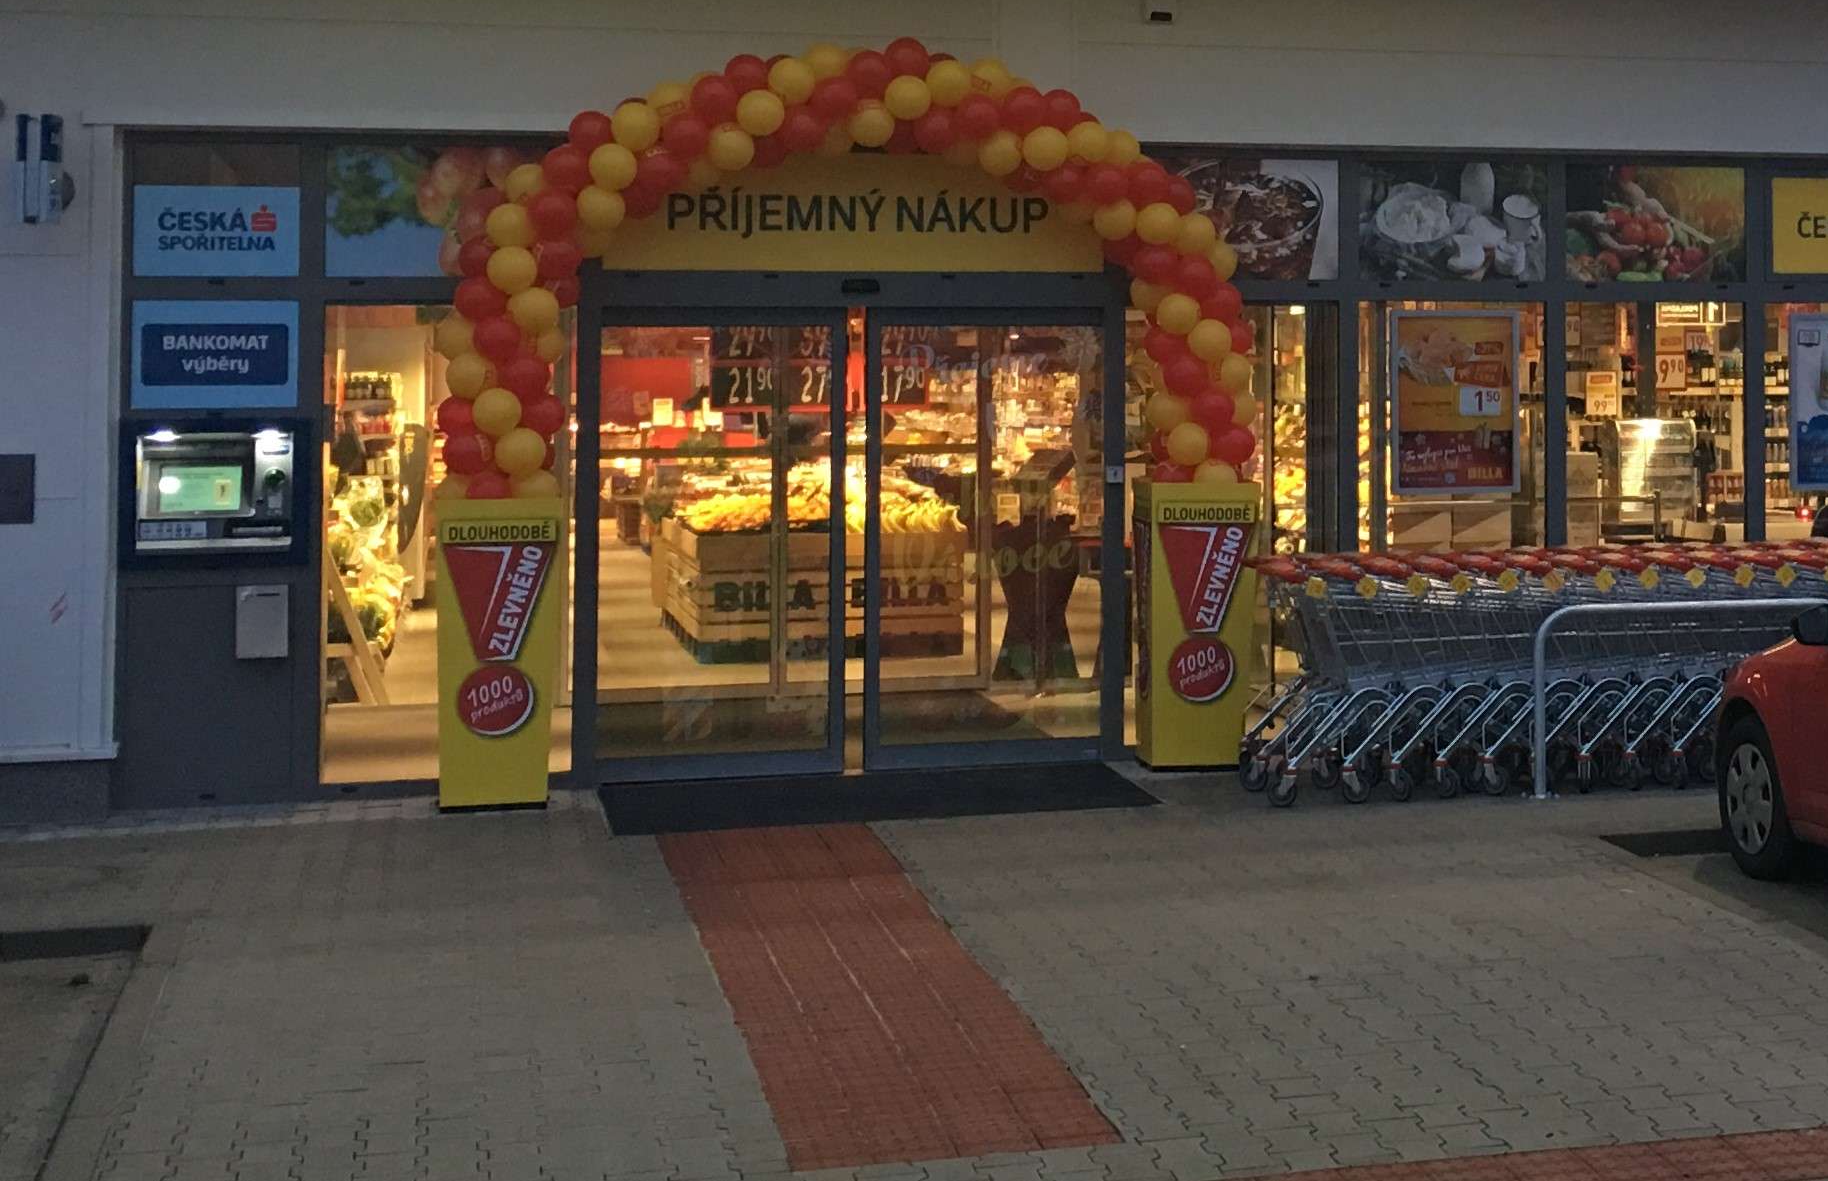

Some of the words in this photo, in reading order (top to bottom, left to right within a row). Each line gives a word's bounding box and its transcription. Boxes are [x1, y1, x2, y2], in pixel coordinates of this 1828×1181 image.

[157, 206, 248, 232] ČESKÁ
[666, 185, 887, 239] PŘÍJEMNÝ
[895, 188, 1050, 233] NÁKUP
[157, 234, 276, 252] SPOŘITELNA
[162, 334, 269, 351] BANKOMAT
[181, 355, 250, 374] výběry
[1162, 504, 1251, 520] DLOUHODOBÉ
[448, 521, 551, 541] DLOUHODOBÉ
[1196, 526, 1244, 628] ZLEVNĚNO
[487, 545, 544, 655] ZLEVNĚNO
[713, 578, 817, 613] BILA
[1176, 646, 1217, 675] 1000
[466, 675, 514, 708] 1000
